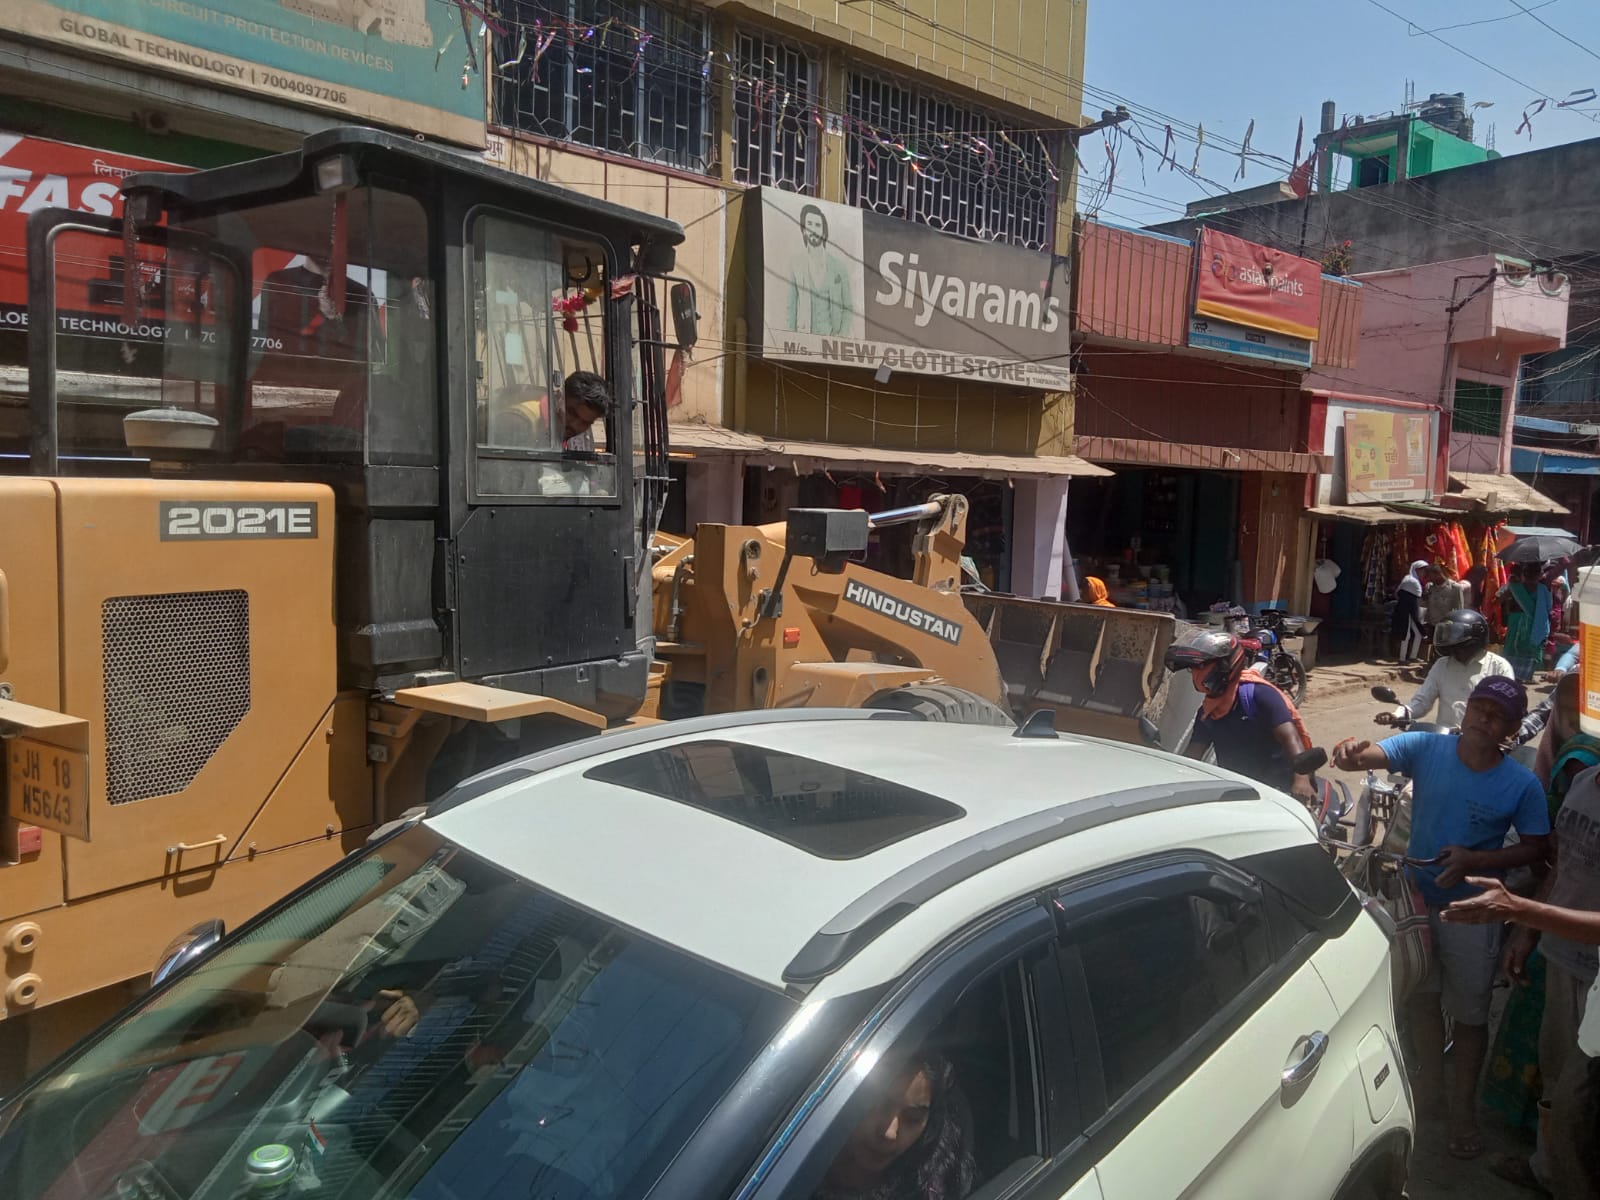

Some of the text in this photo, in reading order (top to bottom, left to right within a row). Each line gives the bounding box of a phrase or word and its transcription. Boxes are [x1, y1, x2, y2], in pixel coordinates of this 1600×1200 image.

[60, 18, 130, 49] GLOBAL
[135, 38, 245, 79] TECHNOLOGY
[262, 73, 347, 104] 7004097706
[223, 14, 328, 55] PROTECTION
[330, 46, 394, 72] DEVICES
[0, 165, 128, 219] FAS
[1269, 272, 1304, 297] paints
[59, 317, 172, 339] TECHNOLOGY
[821, 339, 876, 364] NEW
[883, 347, 956, 373] CLOTH
[168, 507, 312, 535] 2021E
[846, 582, 960, 642] HINDUSTAN
[22, 749, 71, 790] JH 18
